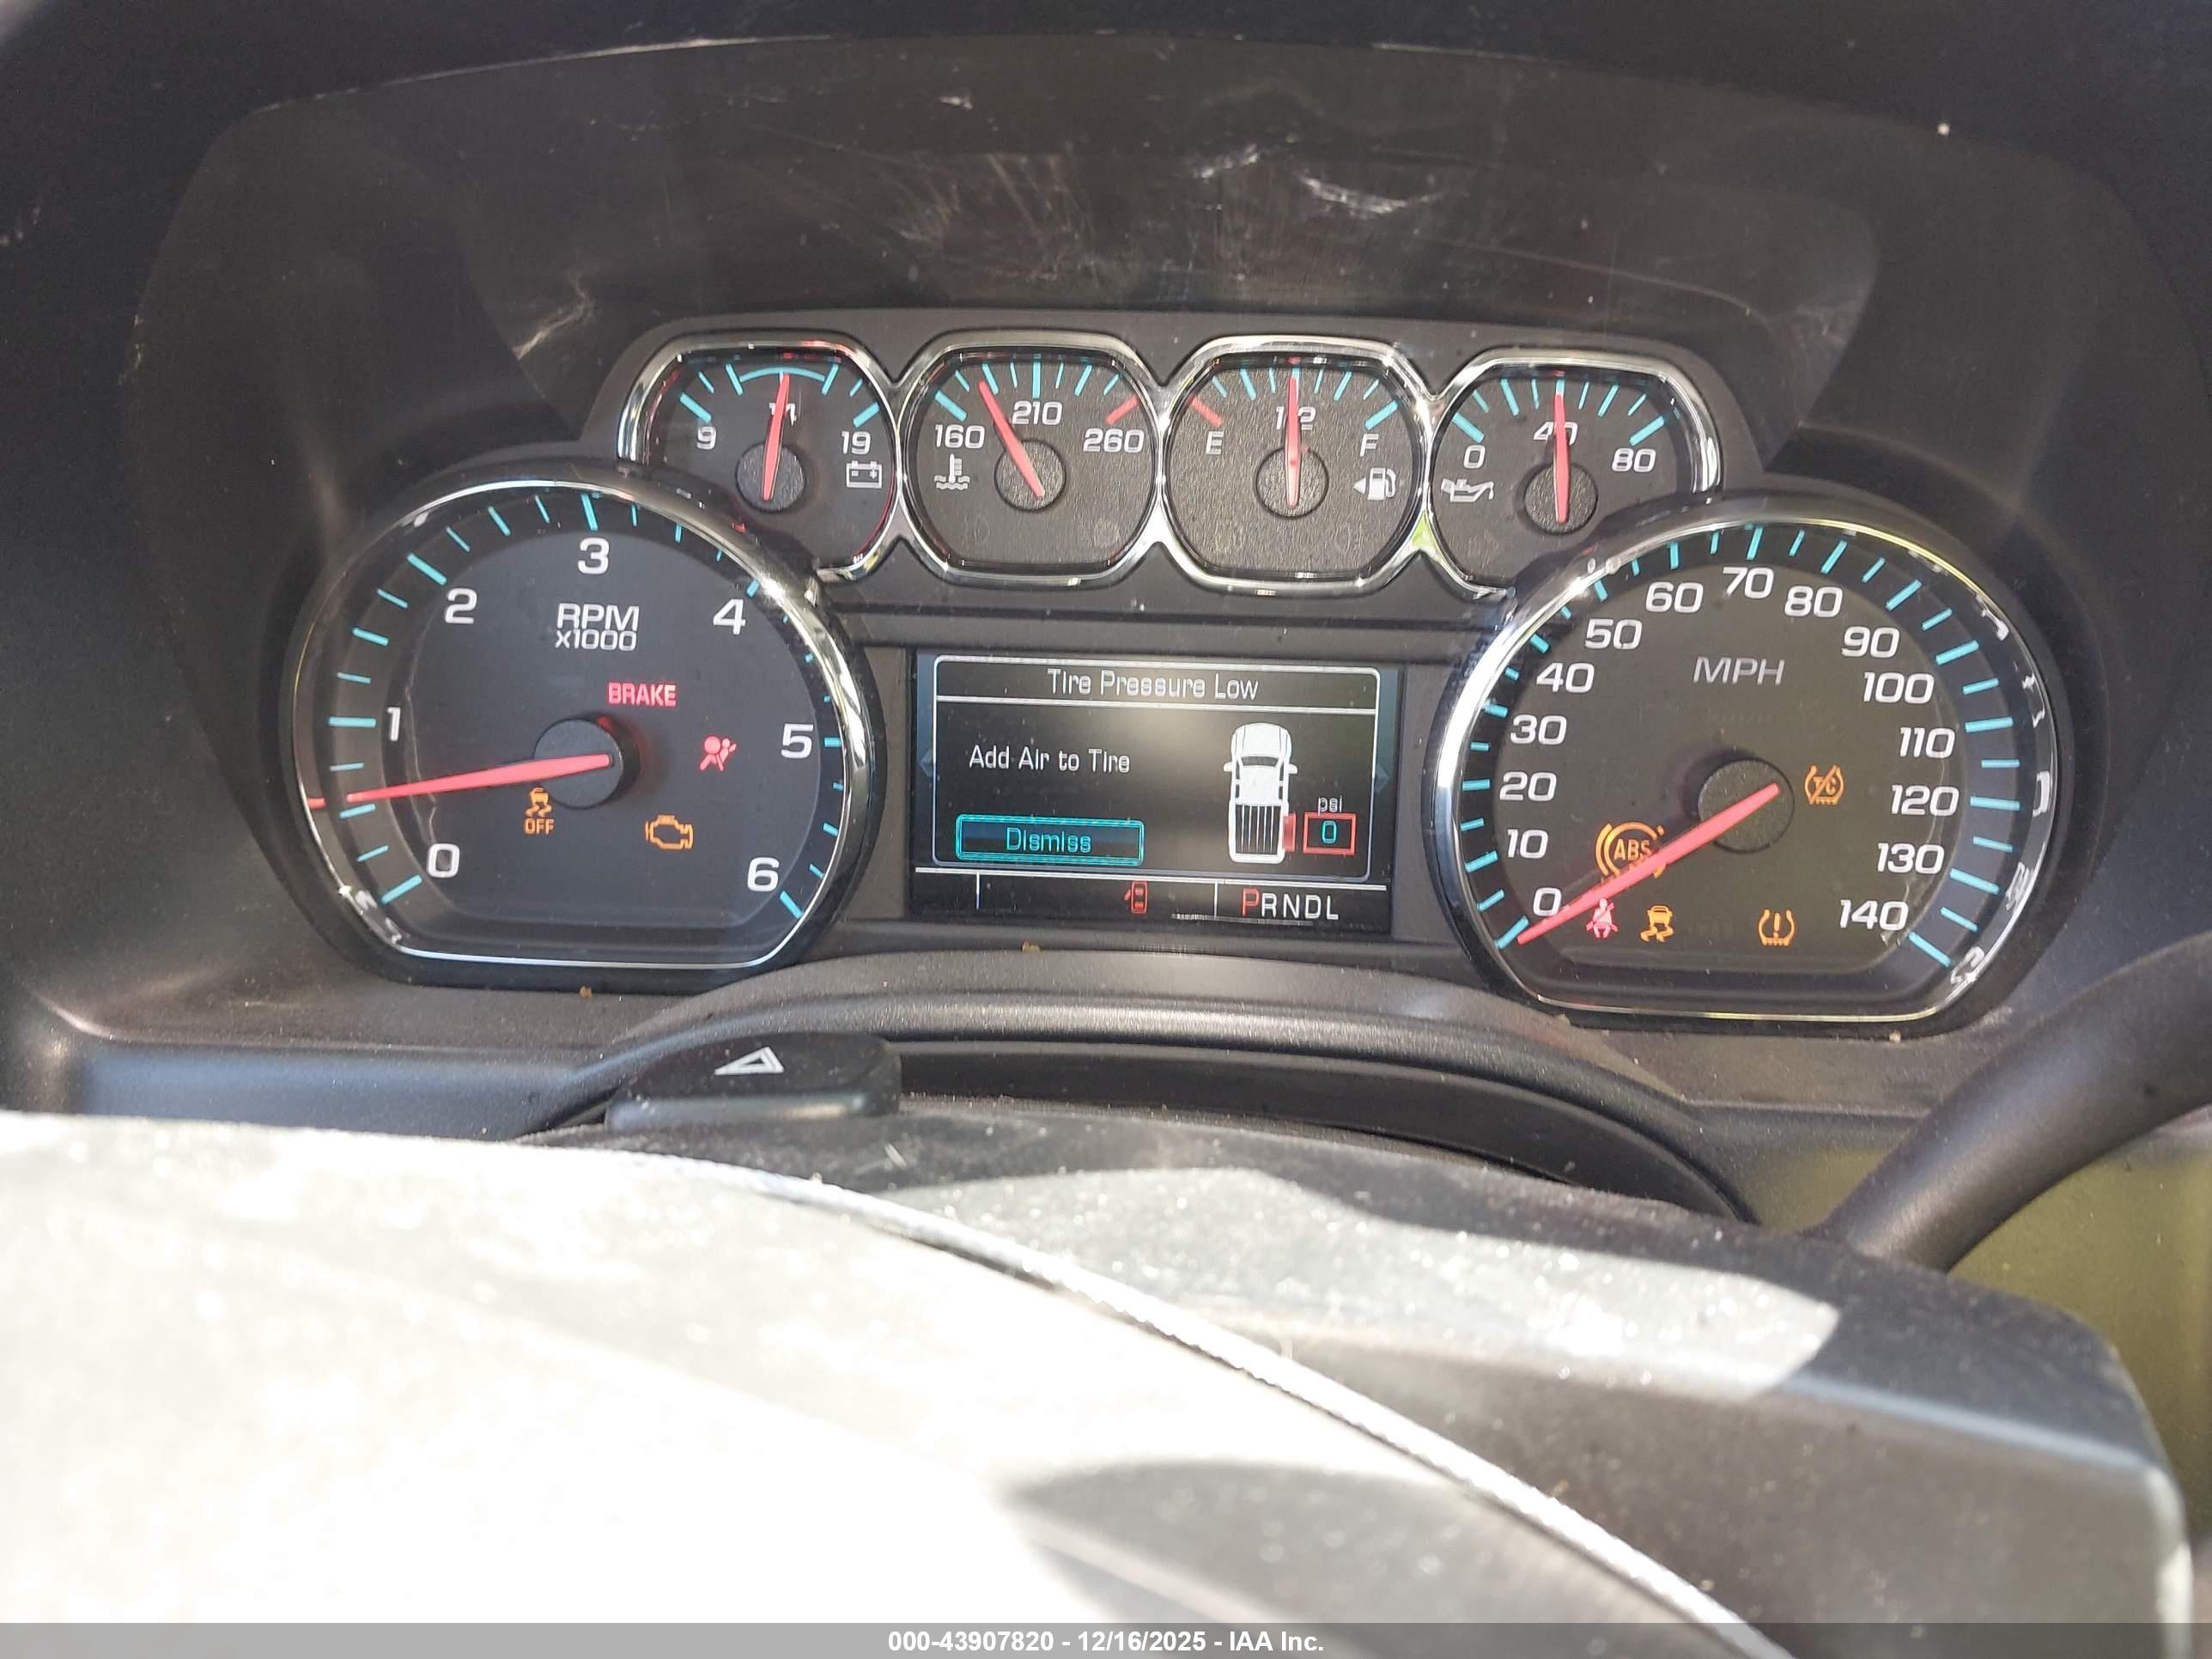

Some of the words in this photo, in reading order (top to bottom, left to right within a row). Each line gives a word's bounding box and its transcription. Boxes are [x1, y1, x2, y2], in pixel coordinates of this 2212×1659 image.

[1012, 401, 1062, 425] 210
[697, 427, 716, 449] 9
[842, 431, 870, 454] 19
[936, 425, 985, 448] 160
[1084, 428, 1144, 453] 260
[1206, 430, 1224, 454] E
[1360, 434, 1378, 457] F
[1464, 445, 1485, 468] 0
[1612, 448, 1656, 471] 80
[578, 538, 609, 574] 3
[1646, 582, 1703, 612] 60
[1723, 568, 1773, 599] 70
[446, 588, 477, 623] 2
[1785, 586, 1842, 617] 80
[557, 604, 639, 631] RPM
[714, 599, 745, 635] 4
[555, 629, 637, 651] x1000
[1585, 619, 1642, 649] 50
[1842, 627, 1899, 658] 90
[1048, 669, 1091, 694] Tire
[1100, 670, 1206, 698] Pressure
[1214, 672, 1259, 700] Low
[1537, 663, 1594, 692] 40
[1694, 658, 1784, 684] MPH
[609, 683, 676, 706] BRAKE
[1864, 672, 1934, 703] 100
[388, 708, 400, 741] 1
[1510, 714, 1566, 744] 30
[781, 724, 813, 758] 5
[1900, 727, 1954, 758] 110
[969, 745, 1009, 769] Add
[1019, 747, 1049, 769] Air
[1059, 750, 1079, 770] to
[1089, 749, 1129, 772] Tire
[1500, 772, 1556, 800] 20
[1318, 795, 1343, 815] psi
[1892, 785, 1959, 816] 120
[526, 818, 554, 834] OFF
[1006, 827, 1091, 853] Dismiss
[1322, 821, 1336, 843] 0
[1508, 830, 1548, 858] 10
[1613, 838, 1654, 860] ABS
[1878, 843, 1944, 873] 130
[428, 844, 459, 878] 0
[748, 858, 779, 891] 6
[1533, 887, 1562, 916] 0
[1839, 899, 1908, 930] 140
